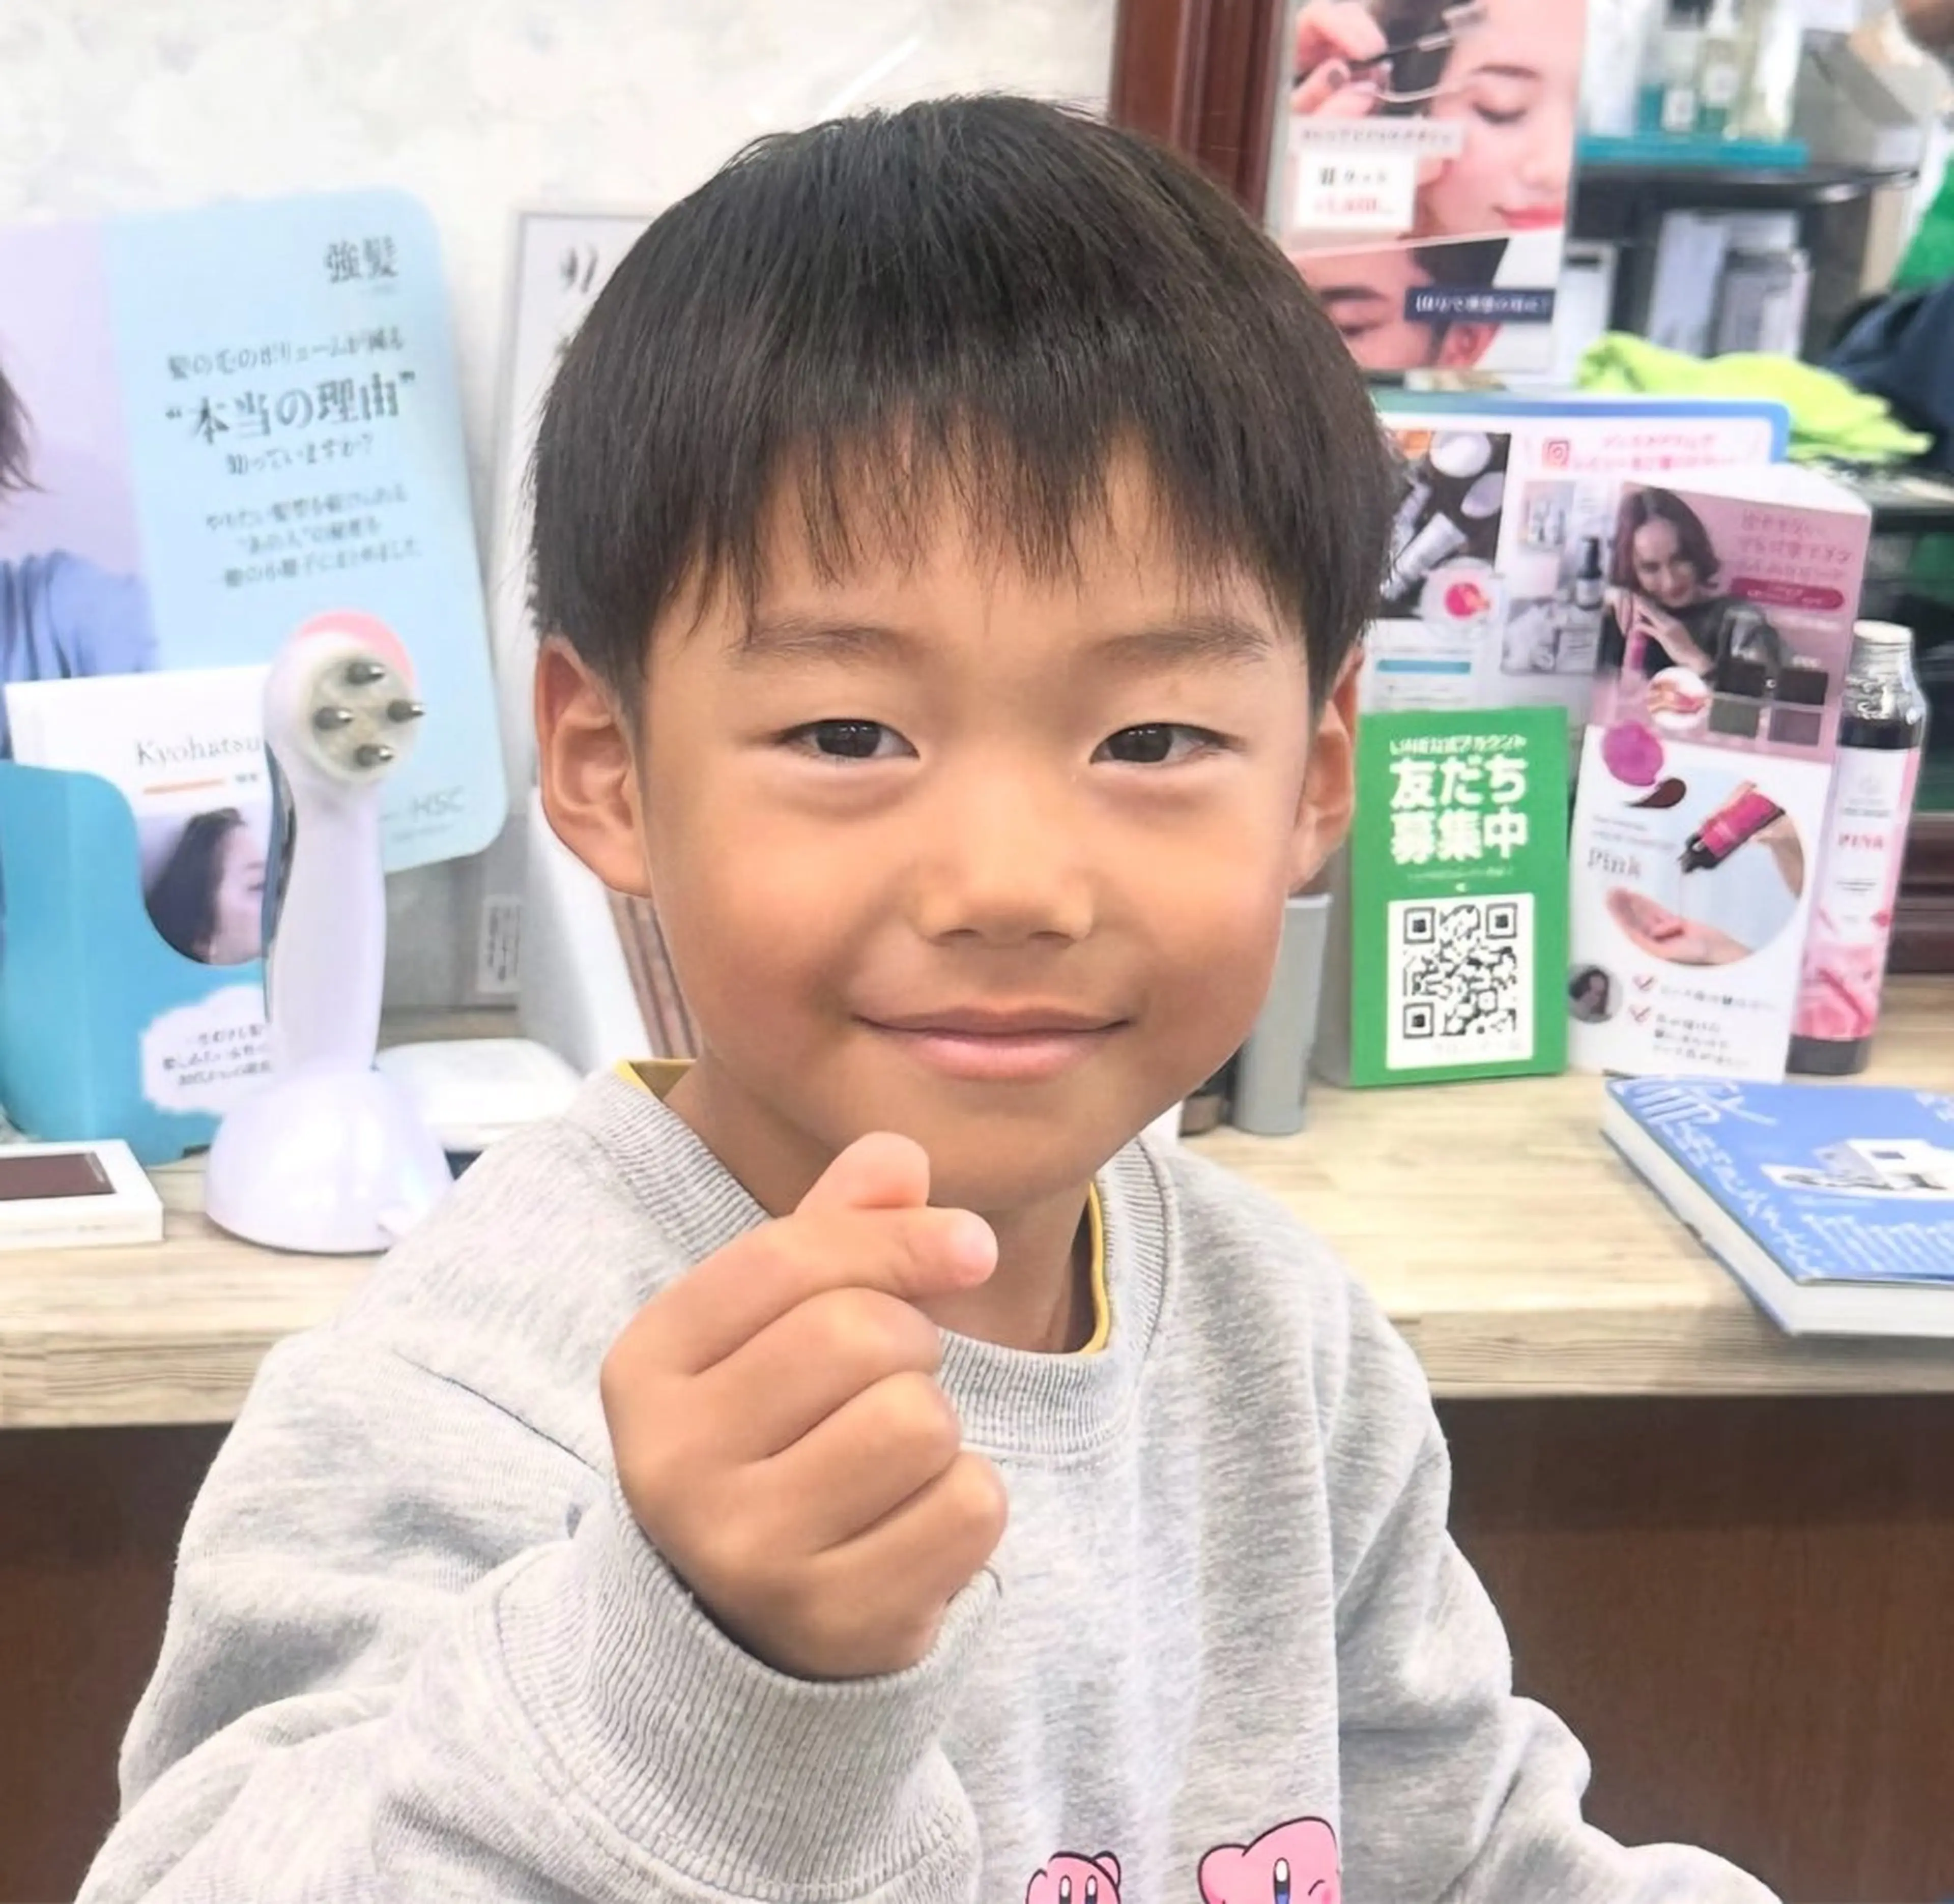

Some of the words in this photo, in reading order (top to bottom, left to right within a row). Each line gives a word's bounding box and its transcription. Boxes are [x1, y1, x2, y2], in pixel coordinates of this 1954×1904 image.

[1389, 753, 1529, 810] 友だち
[1390, 805, 1529, 865] 募集中
